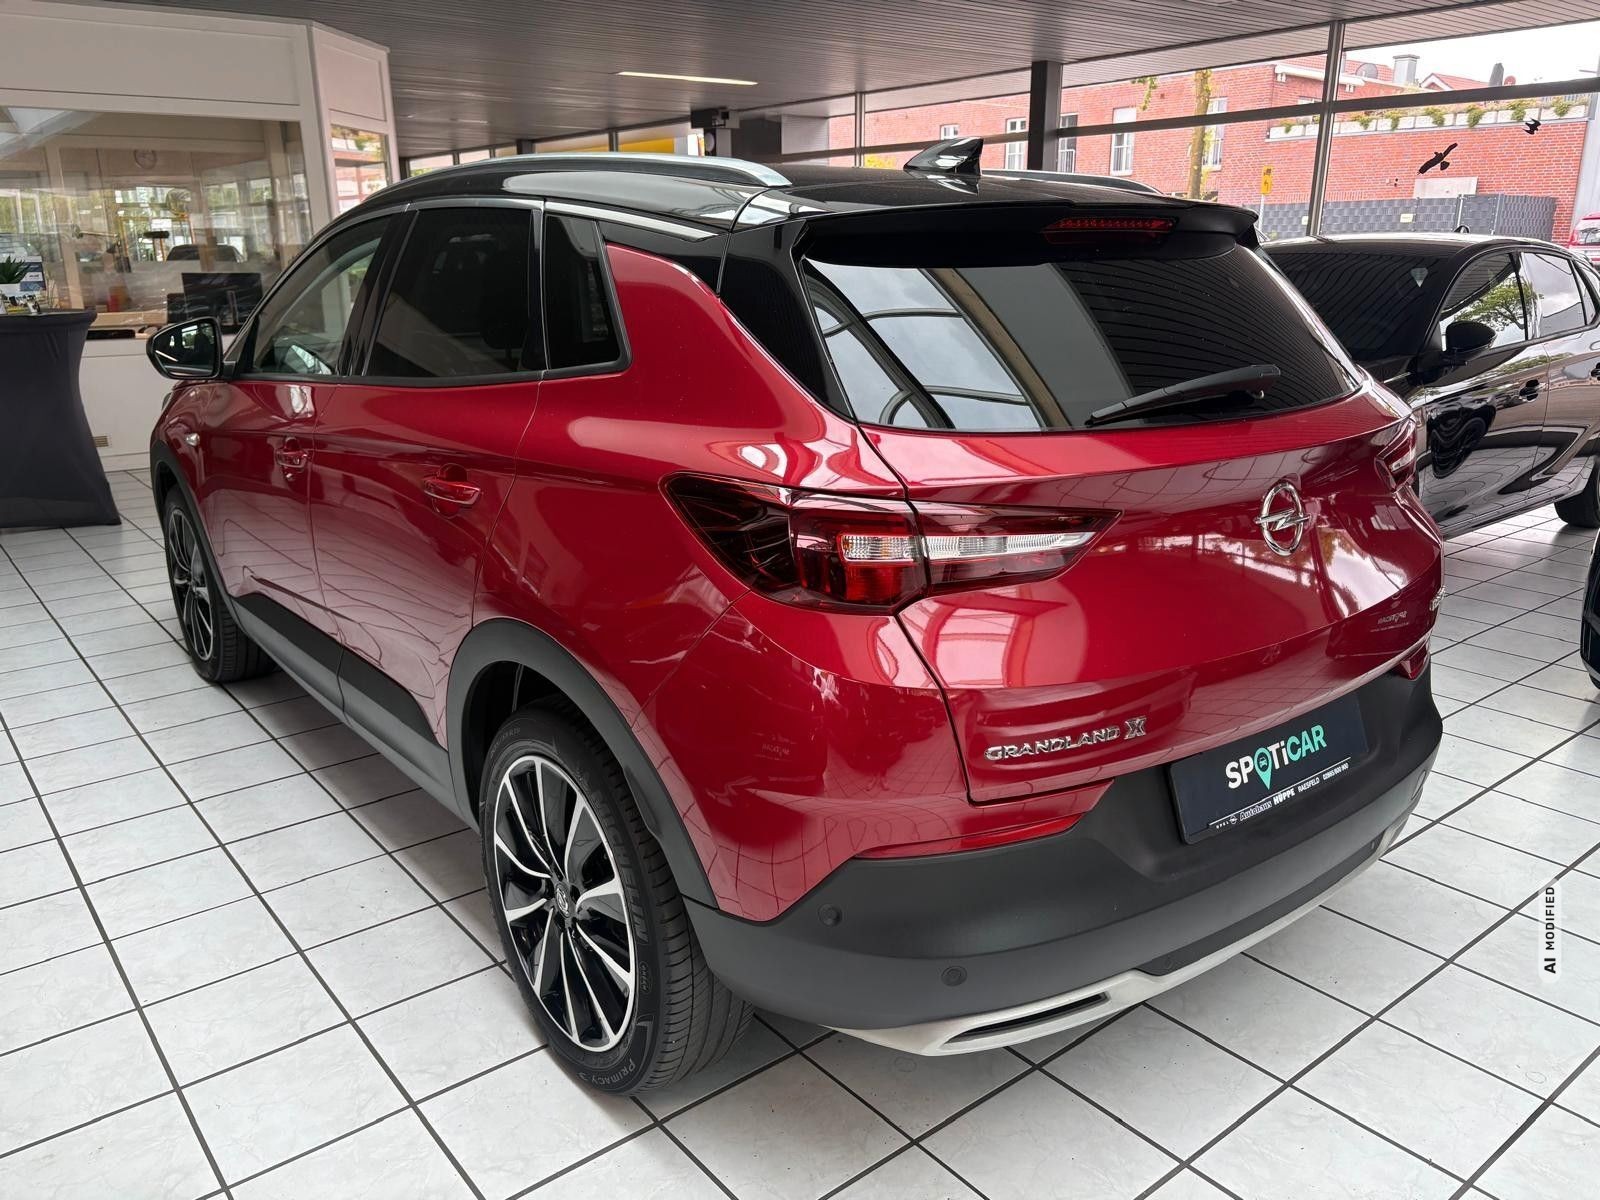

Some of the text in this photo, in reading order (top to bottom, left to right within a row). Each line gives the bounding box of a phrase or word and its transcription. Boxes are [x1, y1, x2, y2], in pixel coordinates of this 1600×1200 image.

[985, 717, 1147, 761] GRANDLAND X
[592, 1058, 636, 1085] PRIMACY
